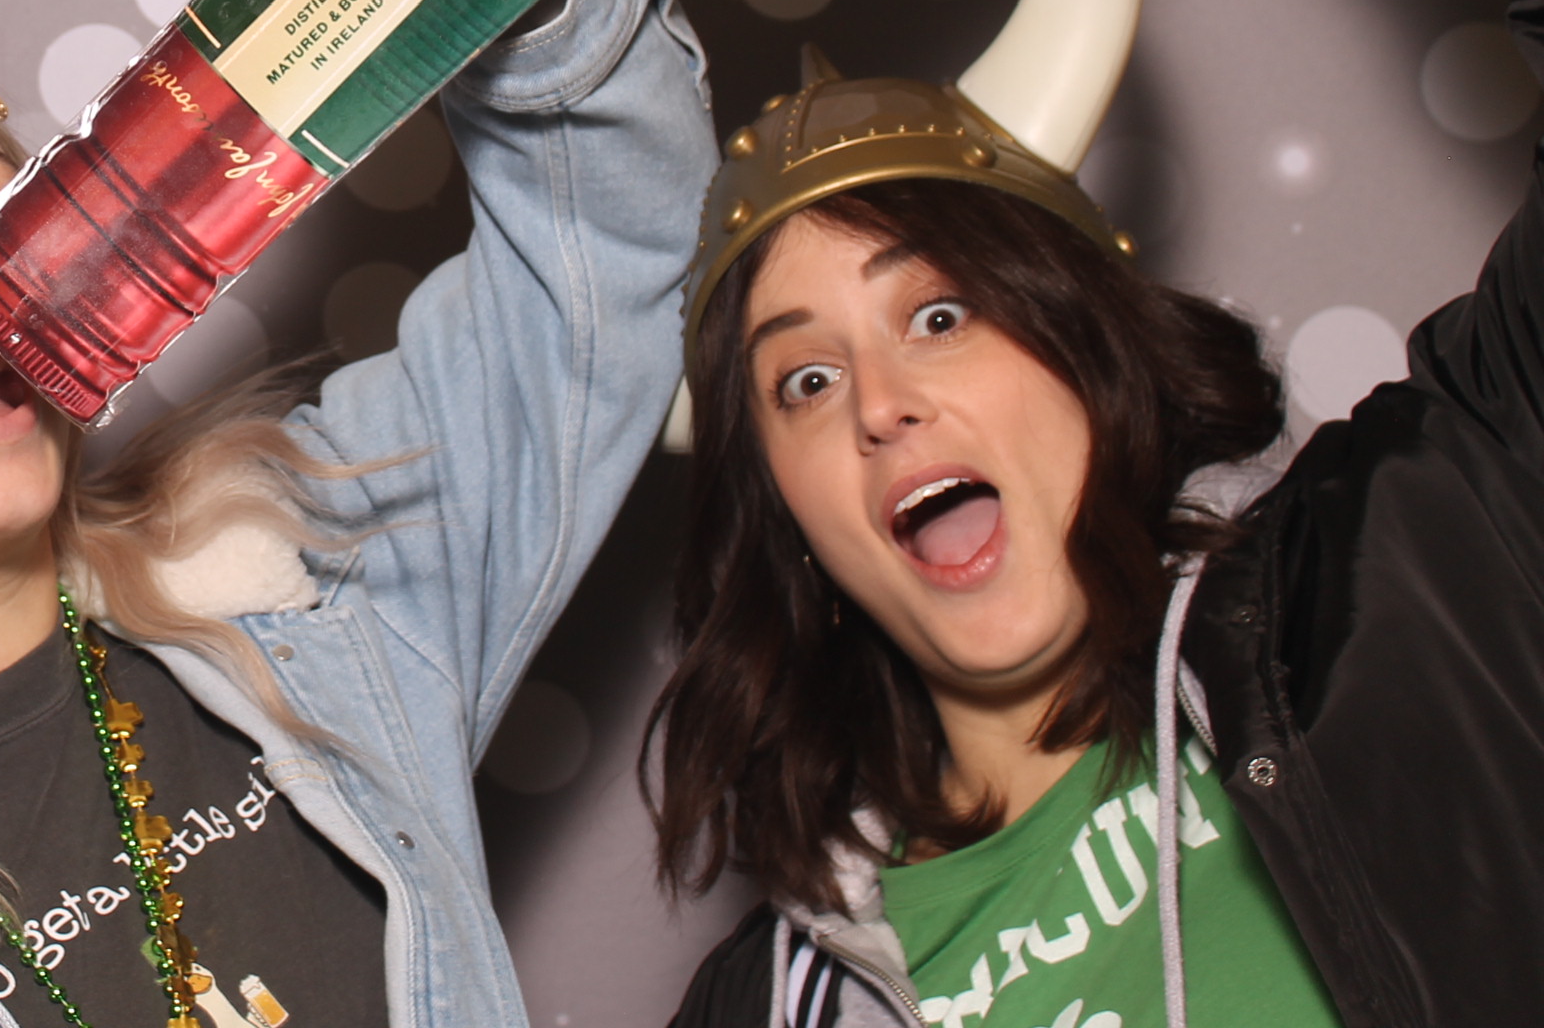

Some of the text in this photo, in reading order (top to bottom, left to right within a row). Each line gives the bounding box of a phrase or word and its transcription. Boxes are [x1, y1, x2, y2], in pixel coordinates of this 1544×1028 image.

[266, 22, 328, 84] MATURED
[329, 10, 342, 22] &
[310, 53, 328, 71] IN
[23, 889, 91, 970] get
[86, 886, 131, 915] a
[113, 806, 236, 873] ttle
